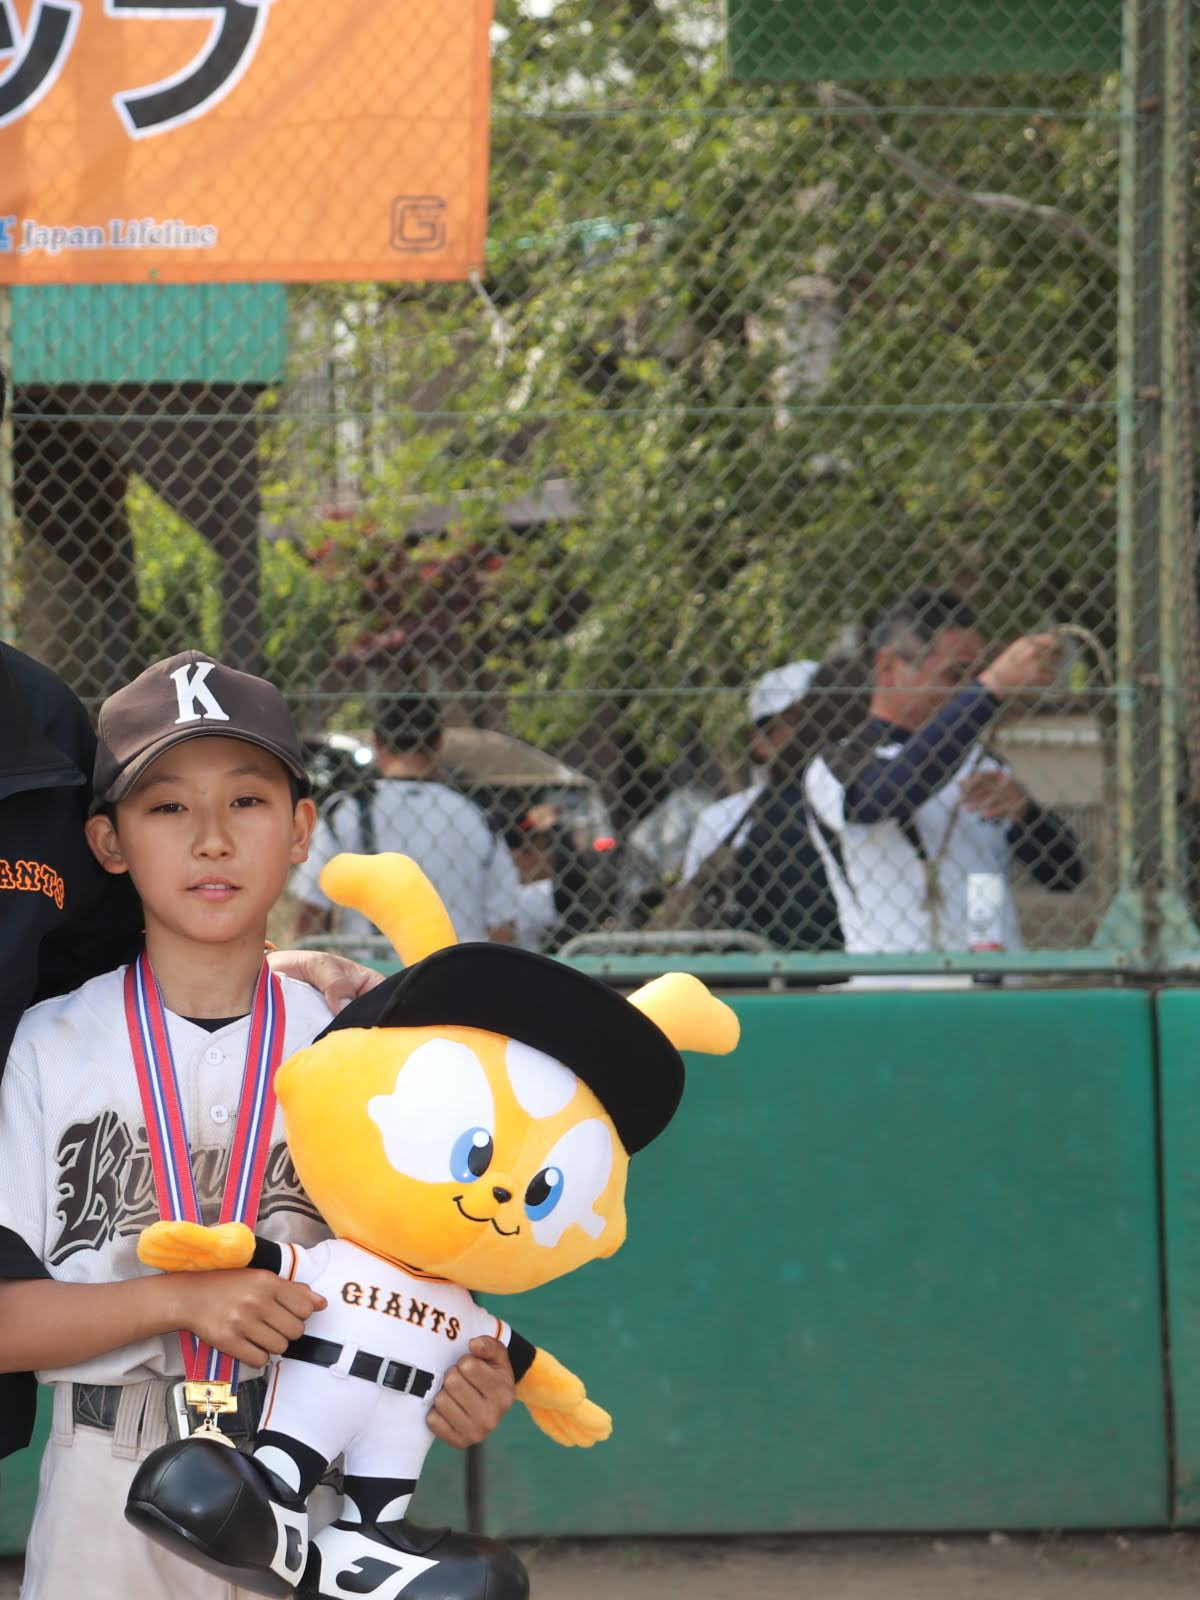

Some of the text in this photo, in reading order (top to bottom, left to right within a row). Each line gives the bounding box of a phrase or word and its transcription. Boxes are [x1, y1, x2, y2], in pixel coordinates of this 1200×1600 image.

[17, 219, 218, 253] Japan Lifeline
[169, 661, 230, 725] K
[340, 1281, 461, 1341] GIANTS
